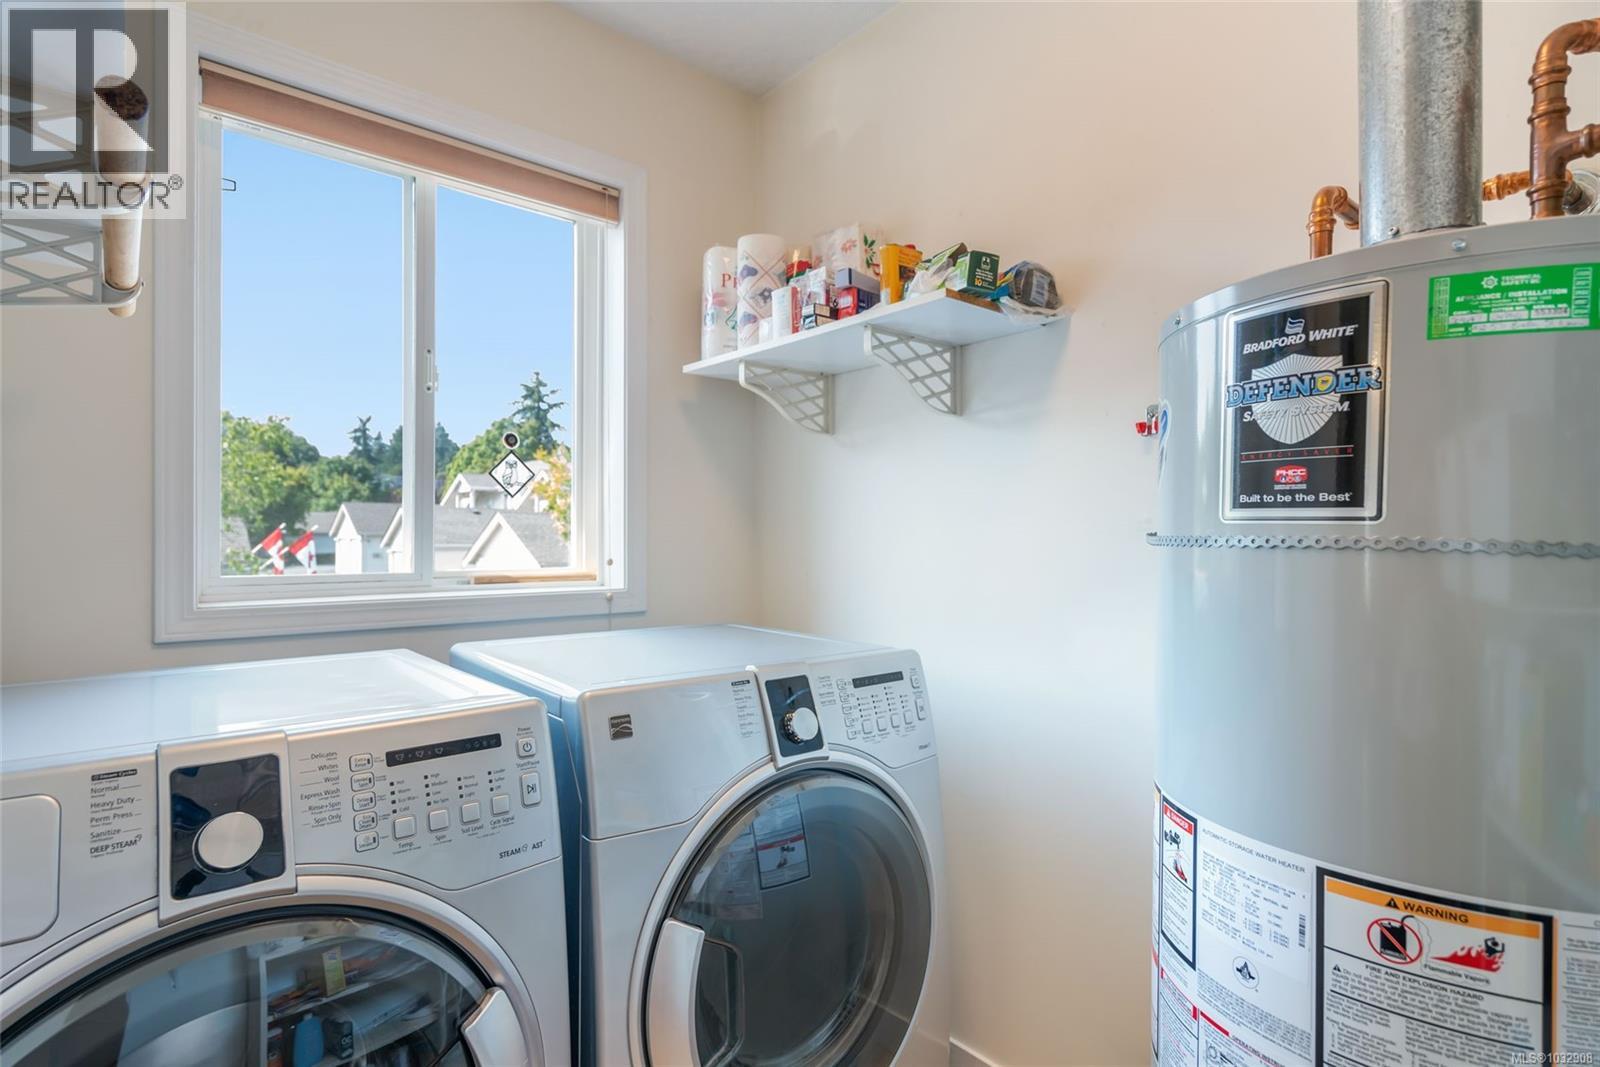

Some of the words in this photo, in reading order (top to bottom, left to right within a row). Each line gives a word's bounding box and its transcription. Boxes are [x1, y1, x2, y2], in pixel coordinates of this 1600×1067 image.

[1242, 333, 1306, 355] BRADFORD
[1308, 325, 1356, 343] WHITE
[1226, 366, 1382, 408] DEFENDER
[1239, 494, 1261, 503] Built
[1262, 494, 1275, 503] to
[1277, 493, 1292, 502] be
[1294, 493, 1316, 502] the
[1318, 492, 1352, 502] Best
[310, 750, 338, 760] Delicates
[318, 763, 339, 771] Whites
[324, 775, 340, 783] Wool
[90, 784, 120, 794] Normal
[300, 791, 323, 801] Express
[324, 788, 341, 796] Wash
[90, 799, 114, 809] Heavy
[116, 796, 135, 805] Duty
[308, 801, 342, 812] Rinse+Spin
[89, 815, 111, 824] Perm
[112, 811, 133, 820] Press
[313, 816, 327, 825] Spin
[327, 813, 342, 821] Only
[90, 828, 121, 840] Sanitize
[89, 844, 110, 855] DEEP
[111, 839, 137, 850] STEAM
[499, 847, 521, 859] STEAM
[1228, 839, 1254, 857] STORAGE
[1254, 850, 1278, 864] WATER
[1278, 858, 1306, 873] HEATER
[1402, 901, 1469, 924] WARNING
[1365, 964, 1382, 974] FIRE
[1384, 969, 1401, 980] AND
[1402, 975, 1448, 993] EXPLOSION
[1449, 989, 1485, 1001] HAZARD
